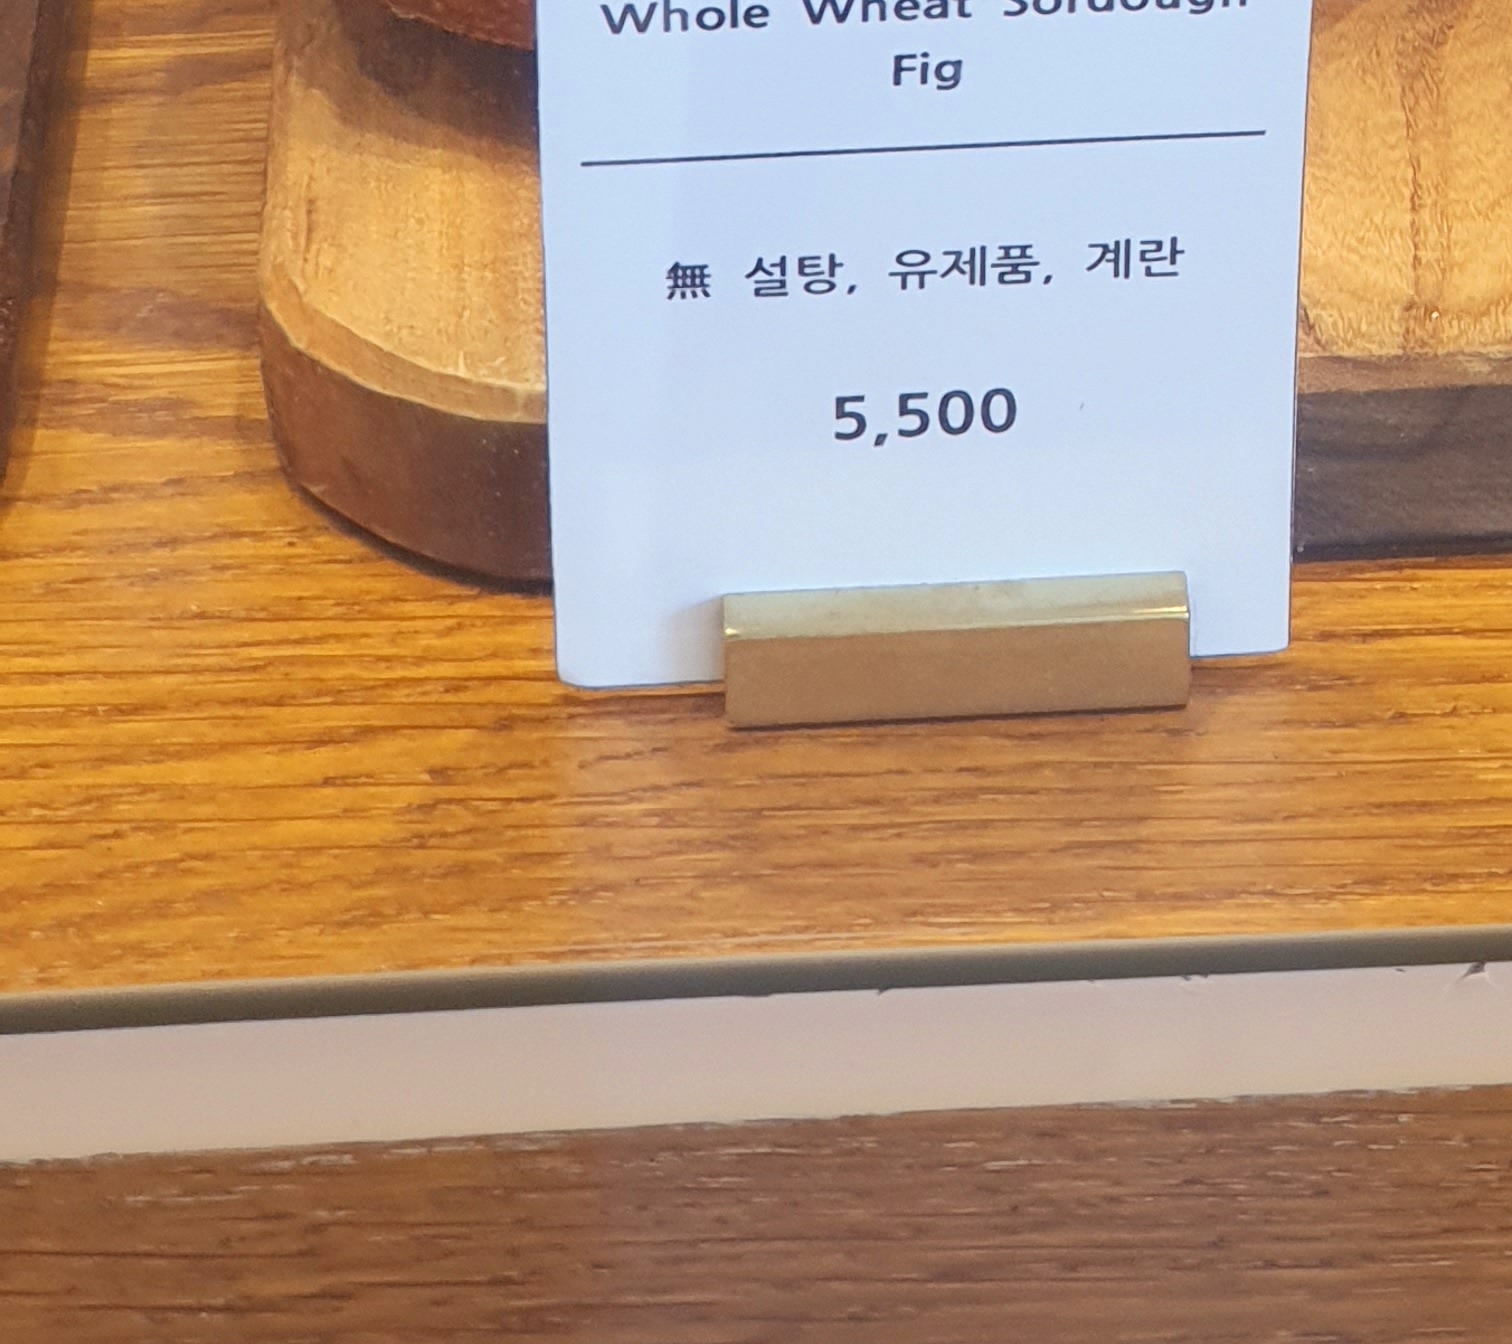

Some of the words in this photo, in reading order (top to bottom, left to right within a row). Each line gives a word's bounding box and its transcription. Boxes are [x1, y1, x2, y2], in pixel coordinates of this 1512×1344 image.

[892, 51, 963, 91] Fig
[665, 261, 712, 301] 無
[744, 252, 857, 298] 설탕,
[888, 244, 1053, 291] 유제품,
[1085, 236, 1185, 280] 계란
[834, 387, 1017, 447] 5,500
